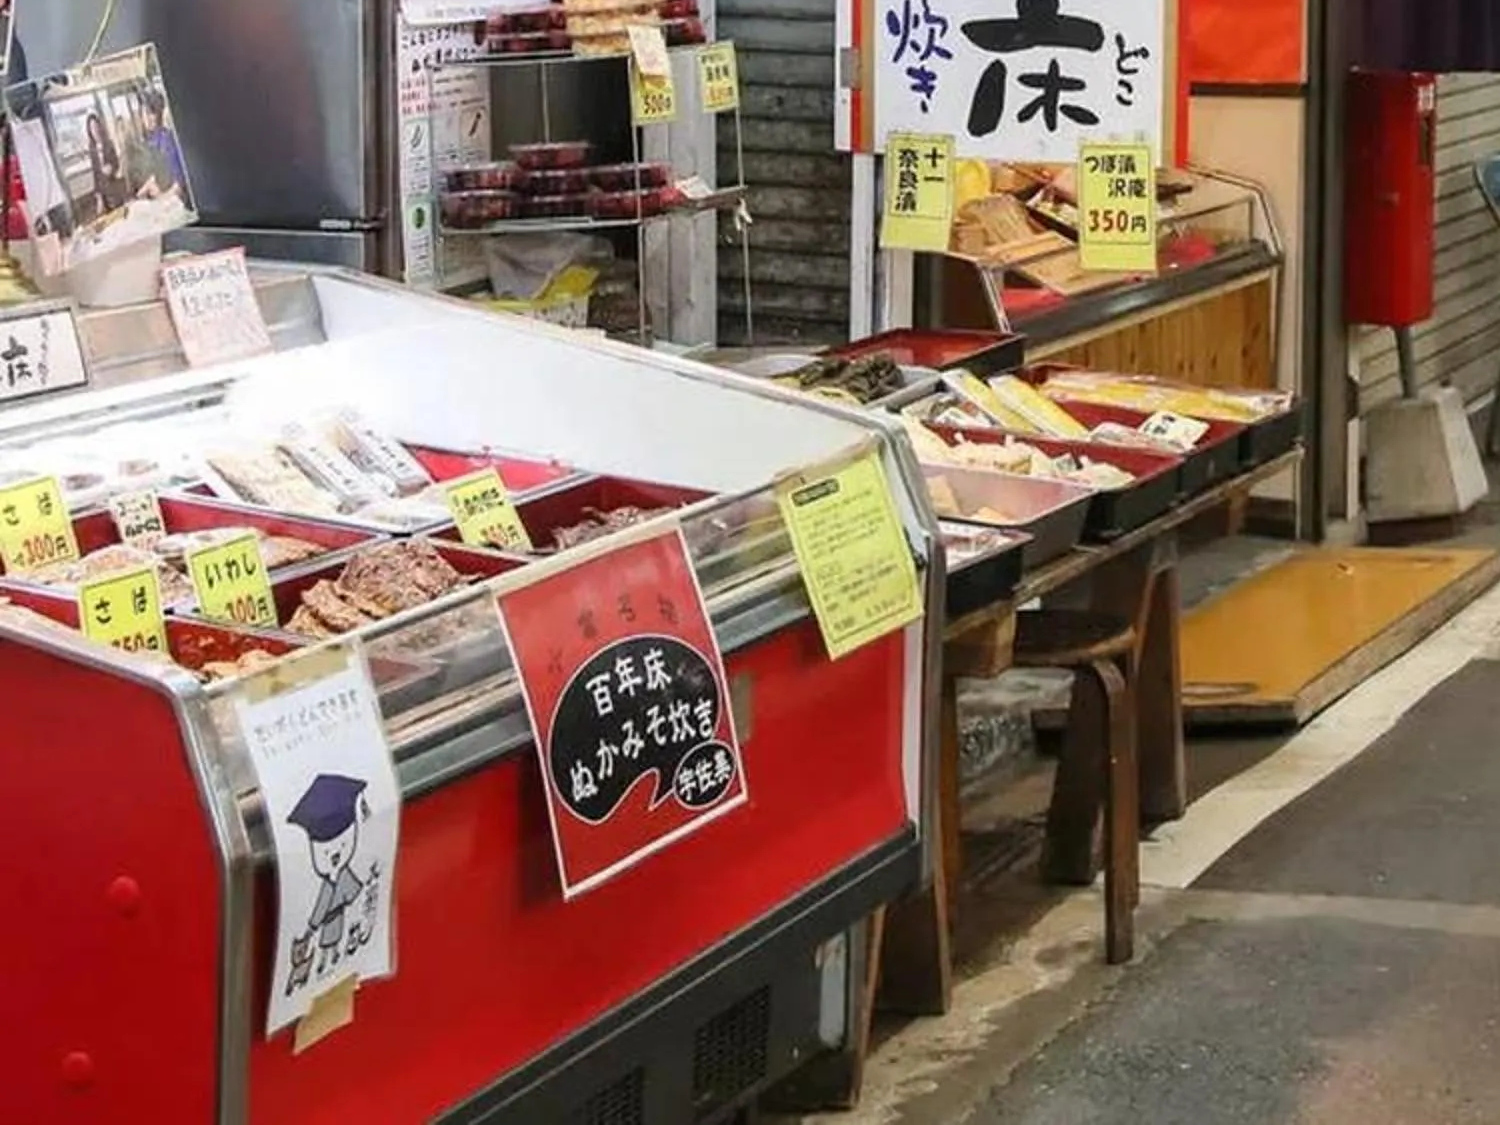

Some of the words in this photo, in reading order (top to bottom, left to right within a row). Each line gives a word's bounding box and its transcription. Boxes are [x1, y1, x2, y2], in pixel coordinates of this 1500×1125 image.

[895, 147, 919, 213] 奈良漬
[923, 146, 945, 183] 十一
[1083, 154, 1137, 175] つぼ漬
[1087, 210, 1148, 234] 350円
[94, 585, 147, 625] さば
[585, 649, 672, 716] 百年床
[569, 697, 717, 803] ぬかみそ炊き
[678, 751, 734, 802] 宇佐美
